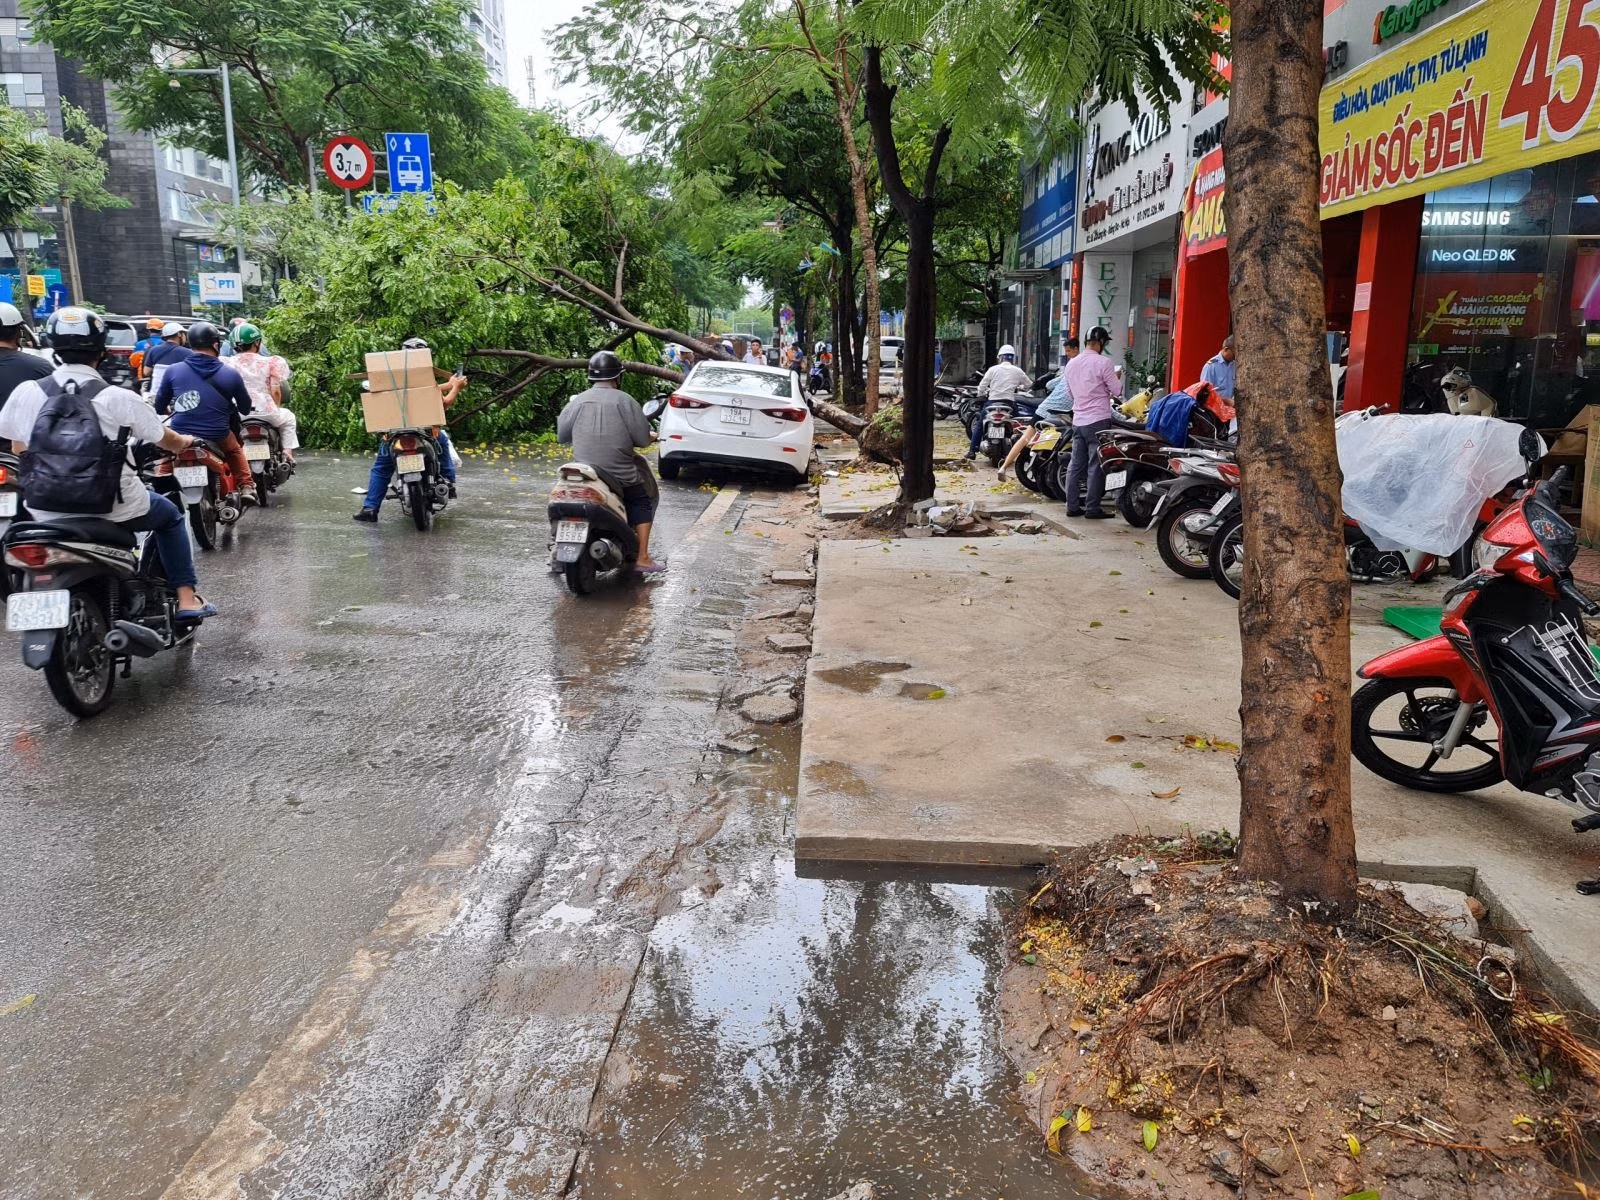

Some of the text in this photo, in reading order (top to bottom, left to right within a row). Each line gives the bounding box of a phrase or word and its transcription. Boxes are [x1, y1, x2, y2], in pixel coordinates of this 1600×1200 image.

[1333, 90, 1350, 123] ĐIỀU
[1371, 78, 1394, 107] QUẠT
[1394, 62, 1416, 95] MÁT,
[1417, 55, 1437, 85] TIVI,
[1440, 40, 1454, 75] TỦ
[1455, 30, 1488, 73] LẠNH
[1319, 76, 1489, 206] GIẢM SỐC ĐẾN
[1096, 130, 1131, 180] KING
[1422, 211, 1511, 226] SAMSUNG
[1432, 249, 1517, 262] Neo QLED 8K
[219, 279, 235, 288] PTI
[1458, 304, 1489, 315] HÀNG
[1489, 304, 1527, 315] KHÔNG
